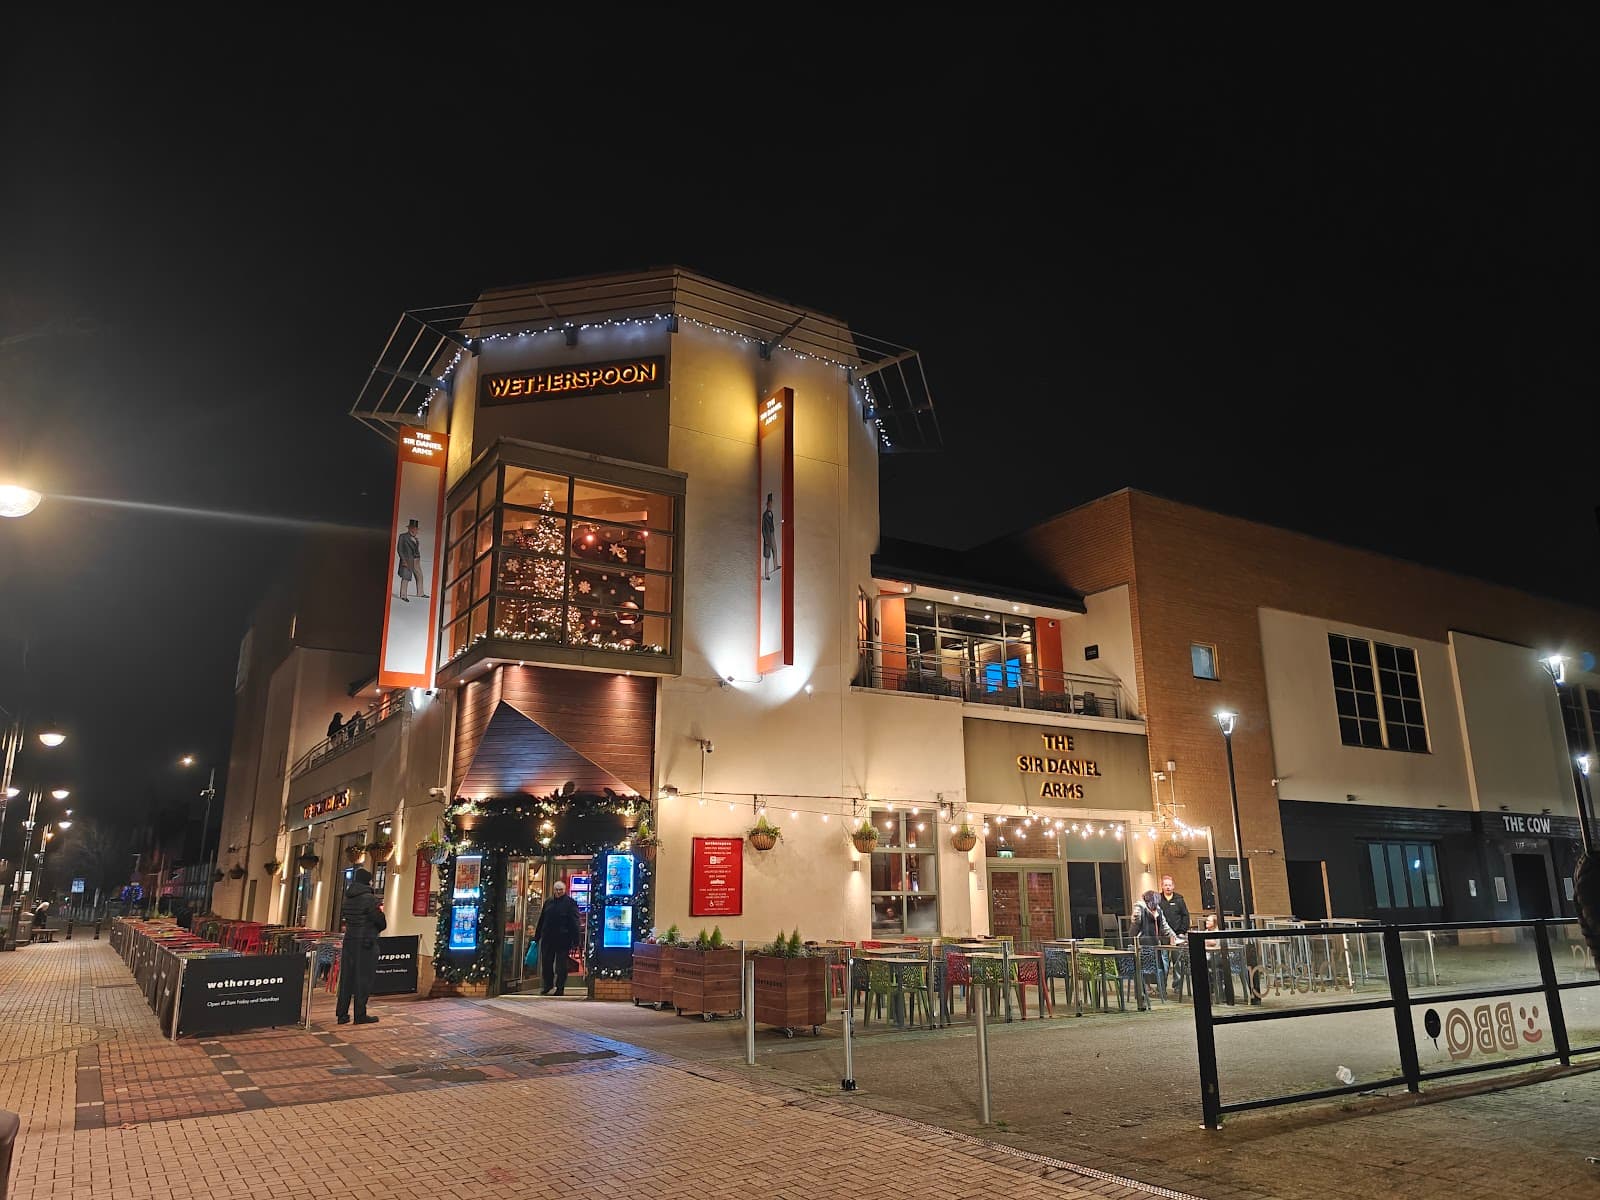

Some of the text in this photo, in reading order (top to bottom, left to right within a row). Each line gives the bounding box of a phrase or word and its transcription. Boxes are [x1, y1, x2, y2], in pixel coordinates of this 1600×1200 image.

[488, 362, 657, 398] WETHERSPOON
[415, 432, 431, 440] THE
[411, 447, 433, 456] ARMS
[416, 440, 443, 450] DANIEL
[1041, 734, 1074, 752] THE
[1017, 756, 1101, 777] SIR DANIEL
[1040, 782, 1084, 800] ARMS
[1502, 816, 1550, 833] THE COW
[207, 977, 284, 989] wetherspoon
